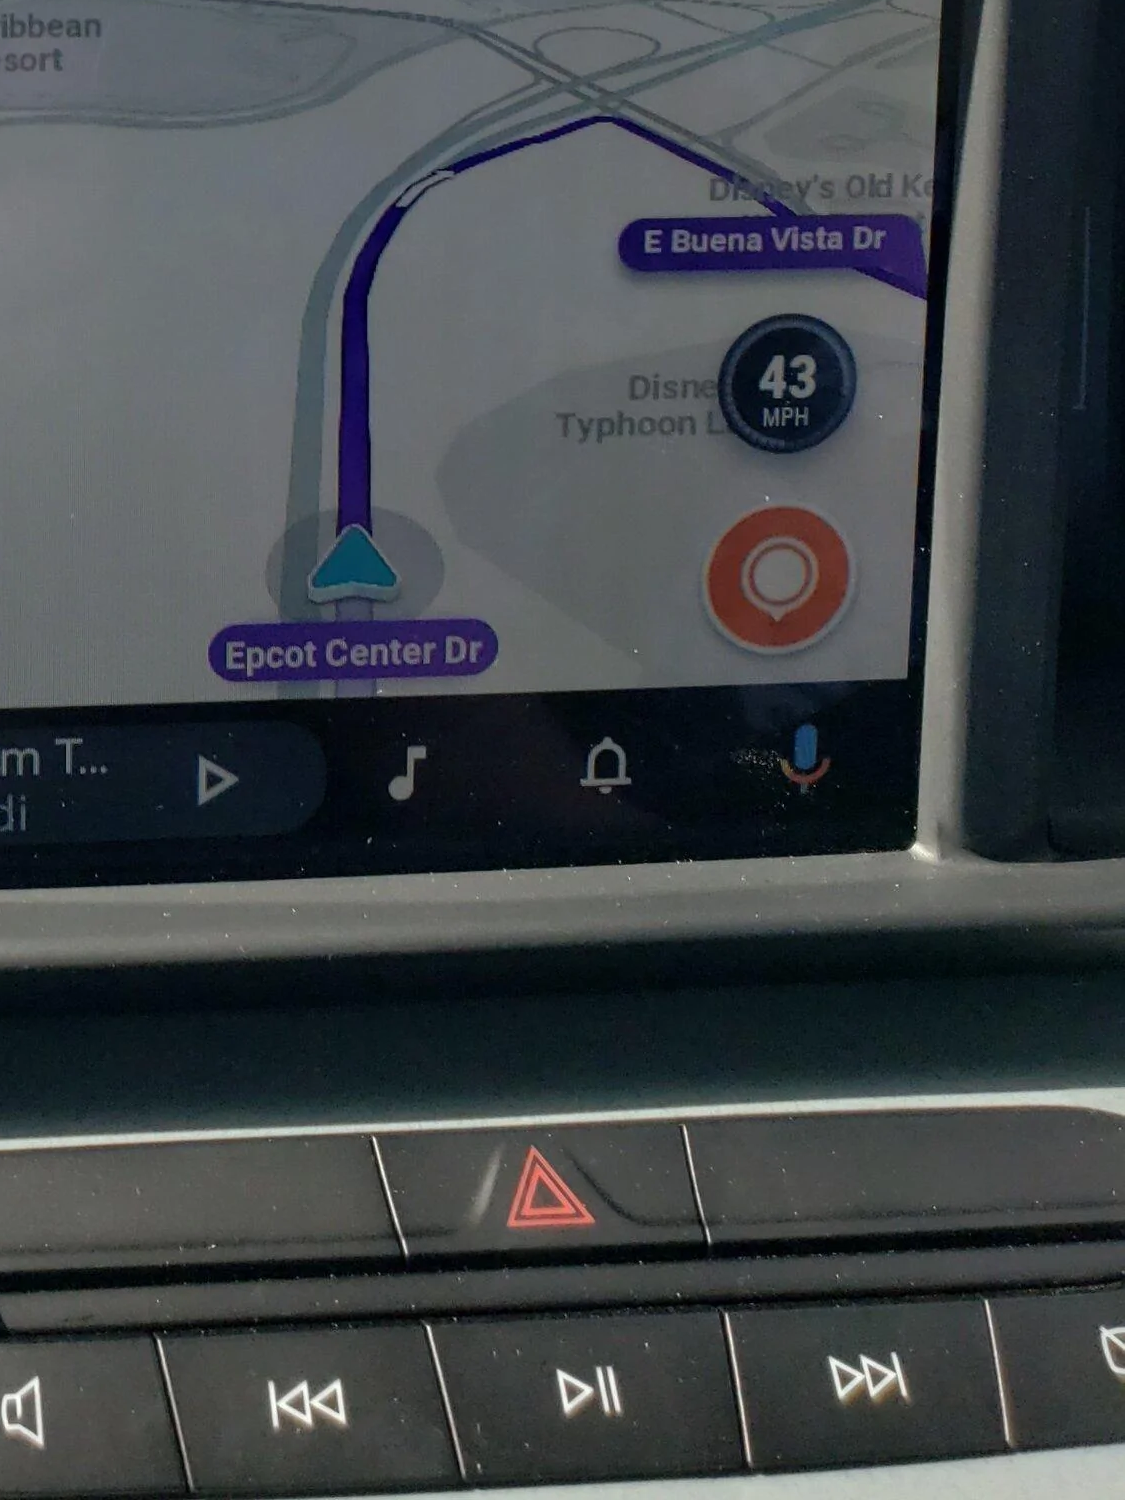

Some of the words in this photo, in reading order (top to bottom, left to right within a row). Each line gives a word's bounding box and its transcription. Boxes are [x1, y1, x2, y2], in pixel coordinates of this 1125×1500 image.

[845, 172, 894, 200] Old
[643, 229, 663, 254] E
[671, 228, 763, 253] Buena
[771, 227, 844, 252] Vista
[853, 225, 887, 250] Dr
[759, 355, 817, 400] 43
[556, 410, 698, 444] Typhoon
[763, 406, 809, 429] MPH
[226, 639, 317, 677] Epcot
[326, 636, 437, 668] Center
[445, 635, 483, 664] Dr
